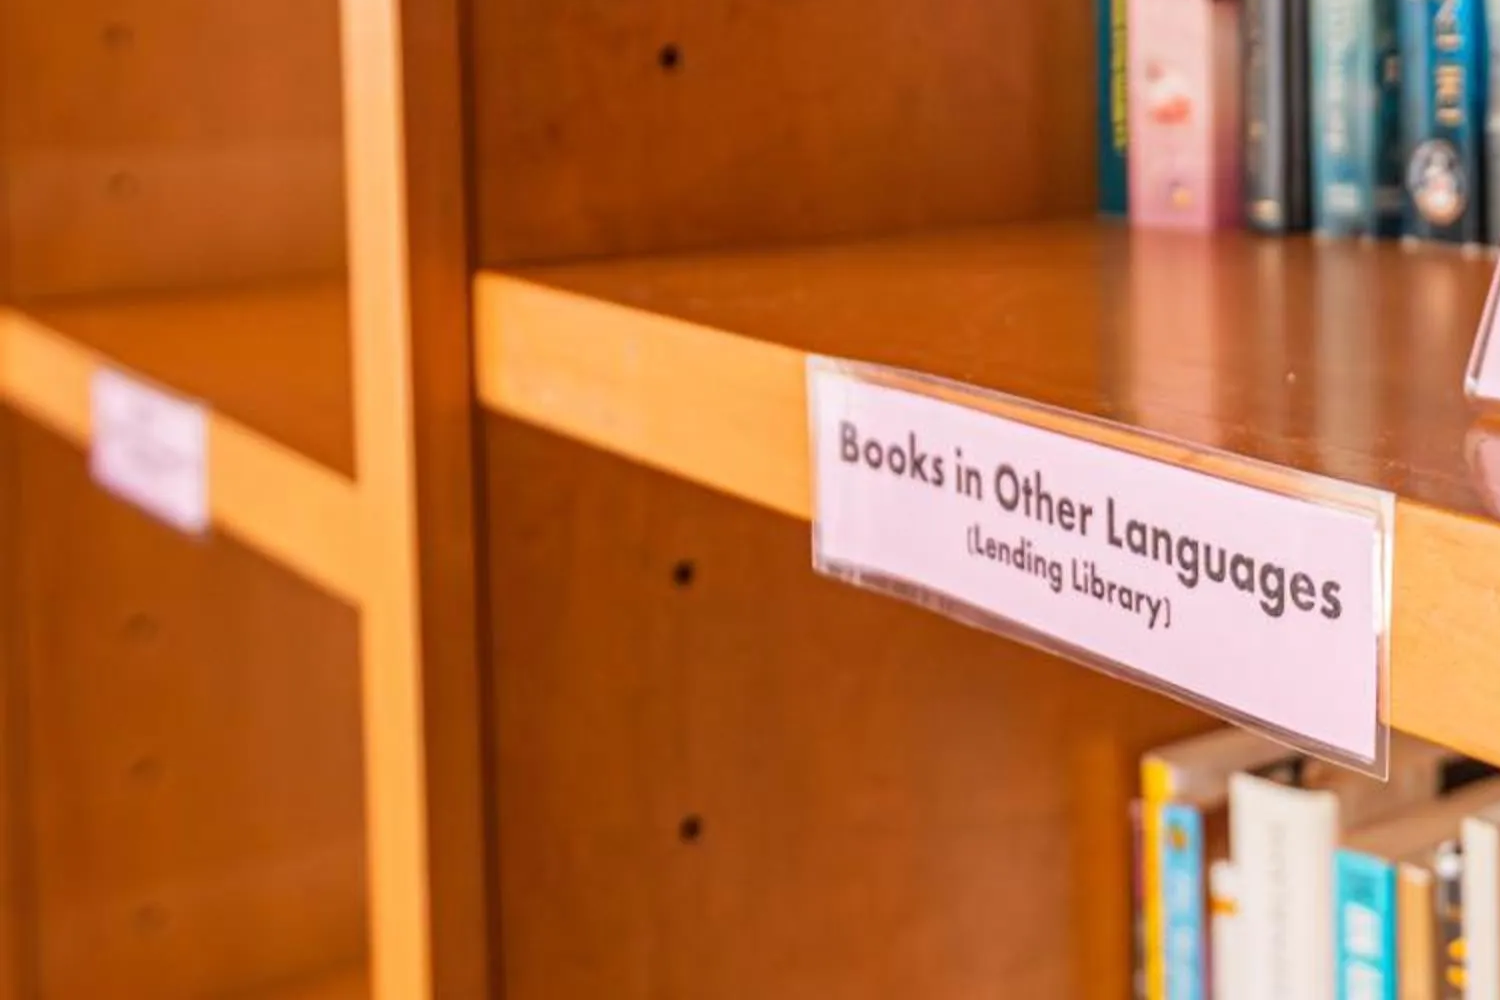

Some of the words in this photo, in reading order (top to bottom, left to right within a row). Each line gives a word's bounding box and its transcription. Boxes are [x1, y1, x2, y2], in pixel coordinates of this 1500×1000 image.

[838, 420, 946, 488] Books
[954, 447, 983, 501] in
[992, 463, 1094, 537] Other
[1106, 496, 1344, 620] Languages
[967, 524, 1064, 595] (Lending
[1071, 558, 1172, 630] Library)
